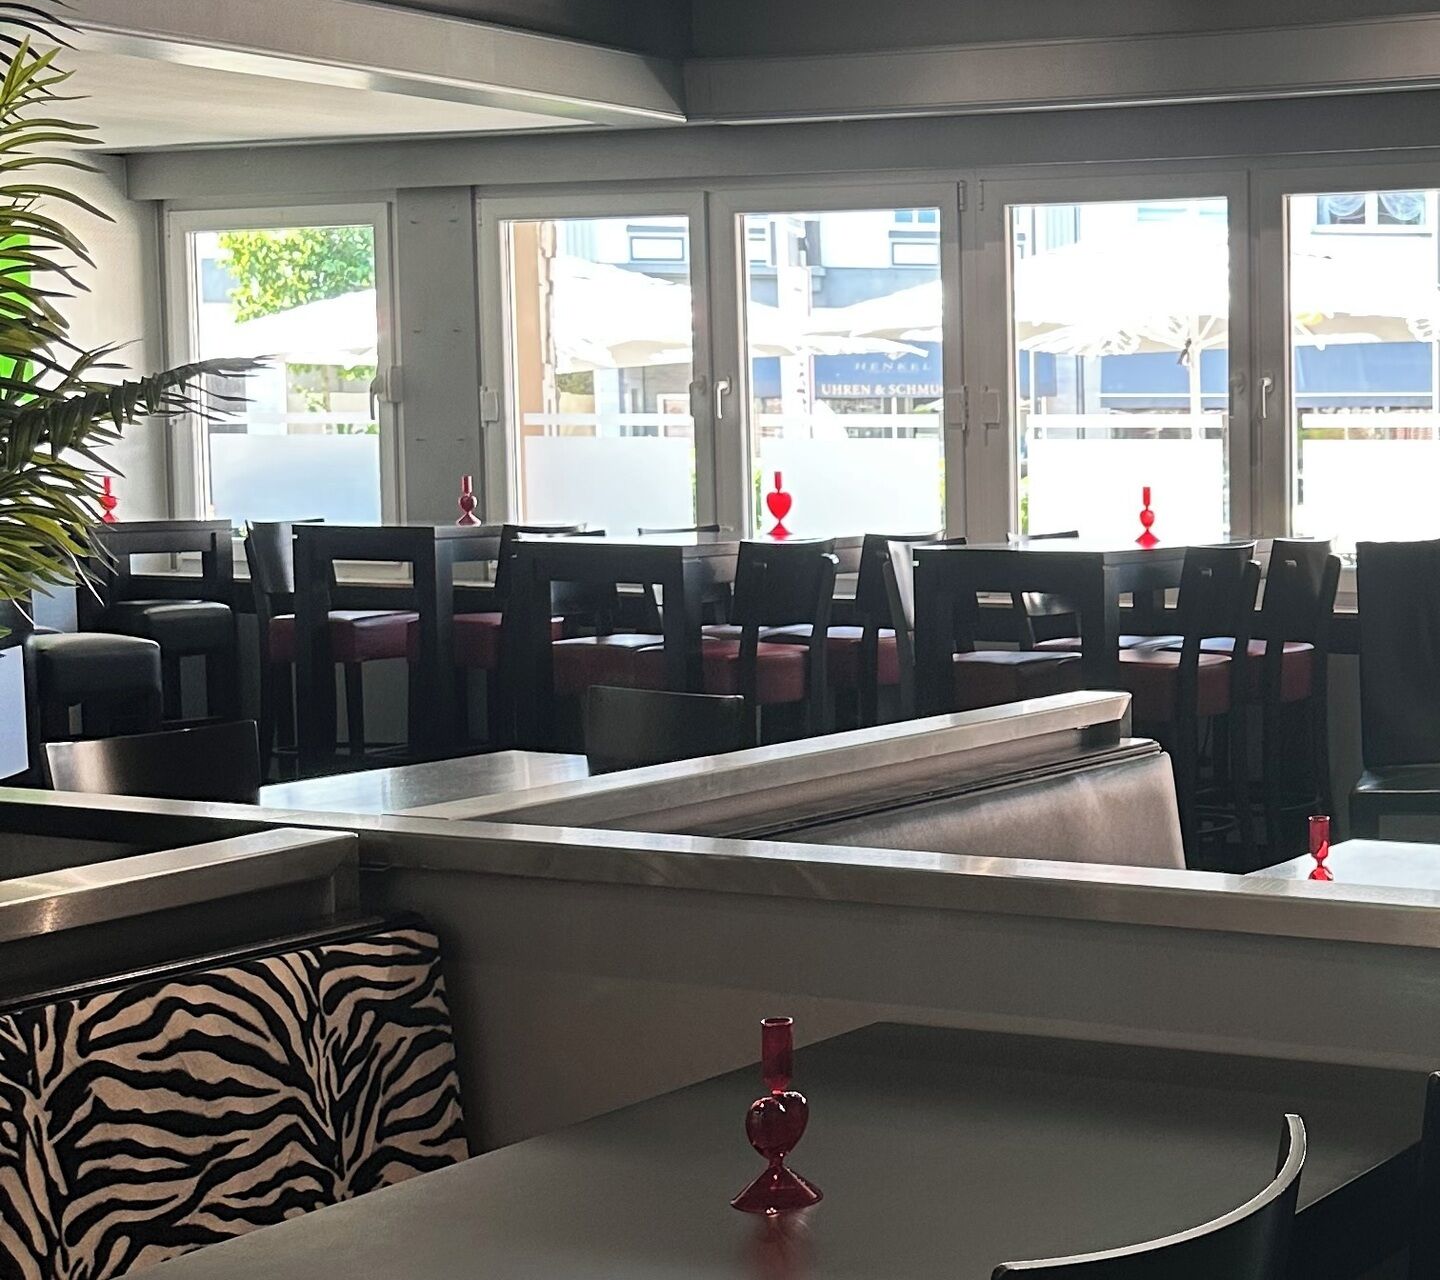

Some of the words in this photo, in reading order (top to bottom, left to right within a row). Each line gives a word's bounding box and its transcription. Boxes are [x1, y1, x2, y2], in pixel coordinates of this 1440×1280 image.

[821, 383, 871, 396] UHREN
[874, 383, 886, 396] &
[888, 383, 943, 396] SCHMU
